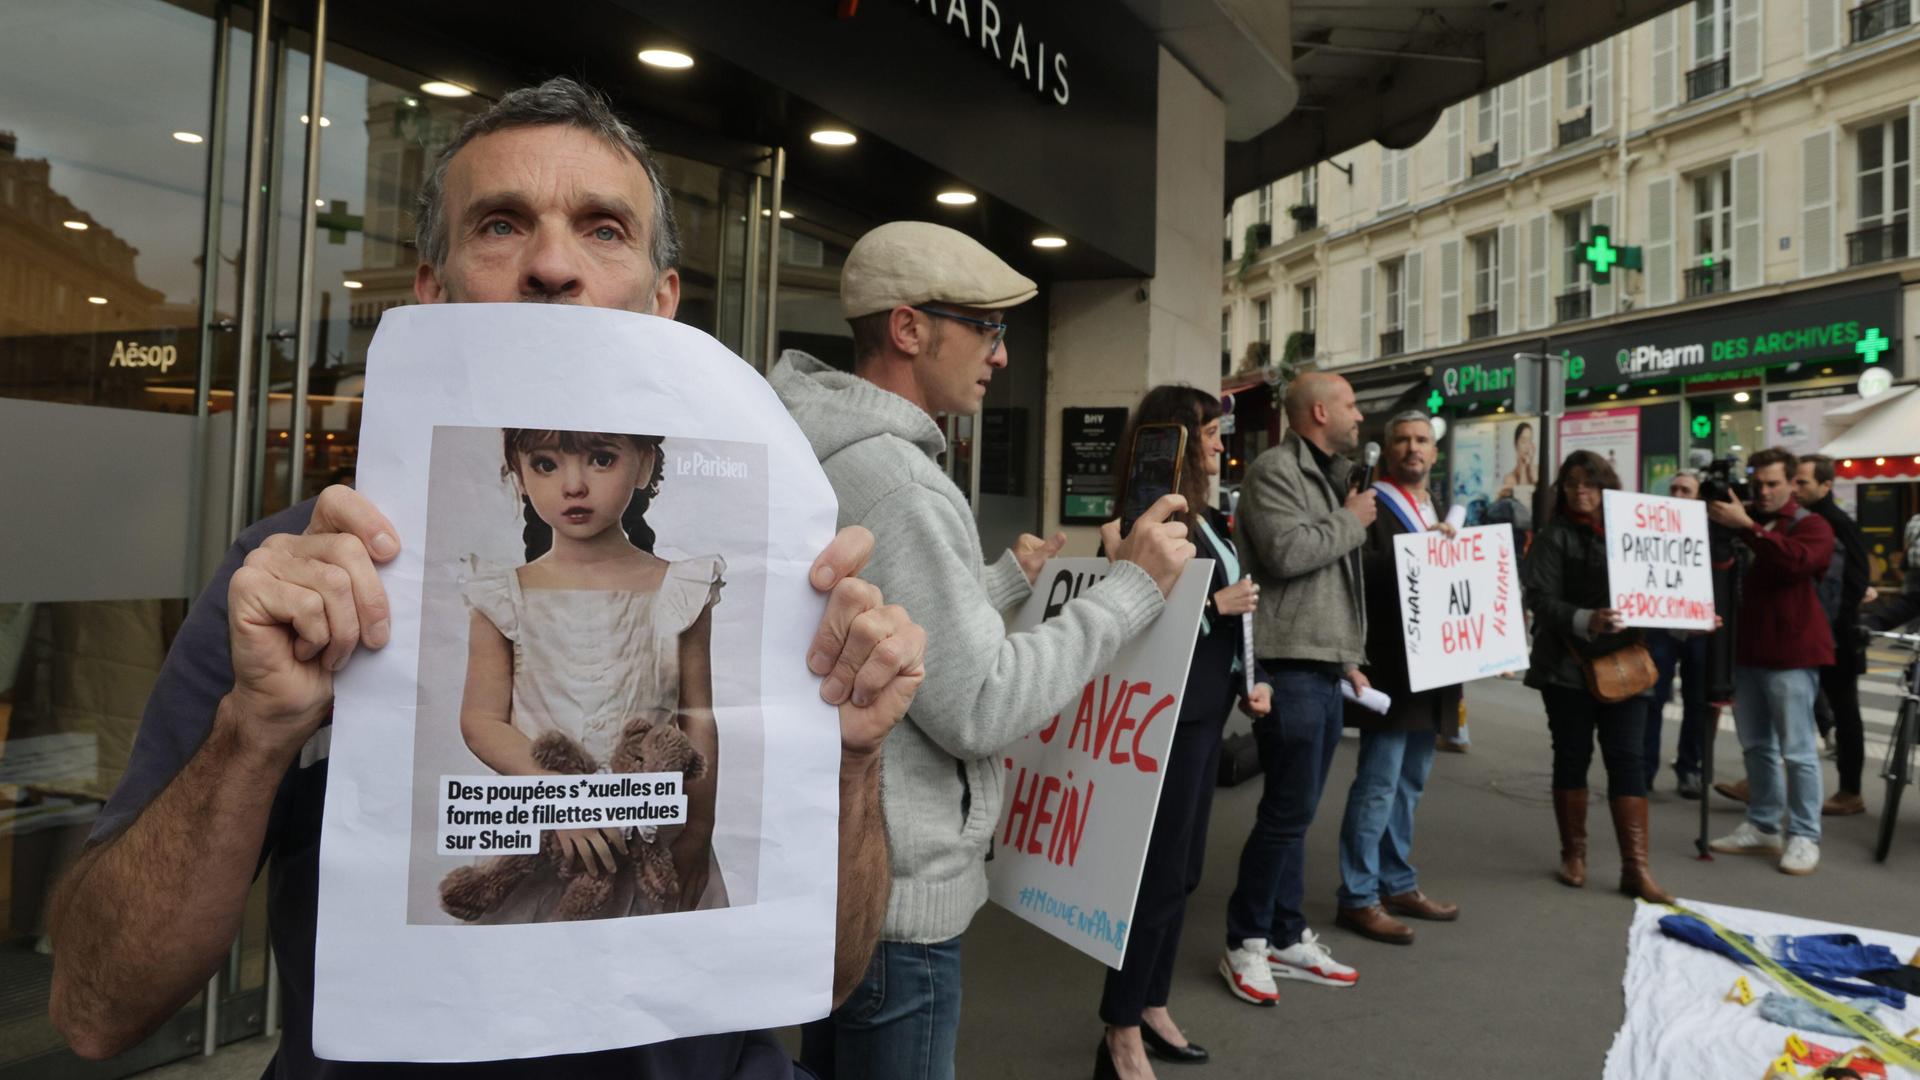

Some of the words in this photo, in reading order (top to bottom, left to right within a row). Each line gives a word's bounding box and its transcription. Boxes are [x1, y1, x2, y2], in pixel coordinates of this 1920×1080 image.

[915, 0, 1069, 105] ARAIS
[1629, 343, 1704, 373] iPharm
[1711, 338, 1748, 361] DES
[1753, 321, 1860, 356] ARCHIVES
[677, 457, 692, 475] Le
[693, 452, 748, 478] Parisien
[1427, 533, 1485, 568] HONTE
[1621, 533, 1704, 567] PARTICIPE
[1665, 569, 1683, 588] LA
[1449, 579, 1471, 615] AU
[1442, 614, 1485, 654] BHV
[1068, 674, 1175, 773] AVEC
[448, 781, 483, 800] Des
[487, 780, 566, 804] poupées
[654, 781, 676, 795] en
[446, 805, 502, 825] forme
[505, 806, 529, 824] de
[532, 804, 602, 824] fillettes
[605, 801, 680, 820] vendues
[1002, 757, 1095, 868] HEIN
[446, 834, 476, 849] sur
[479, 830, 532, 849] Shein
